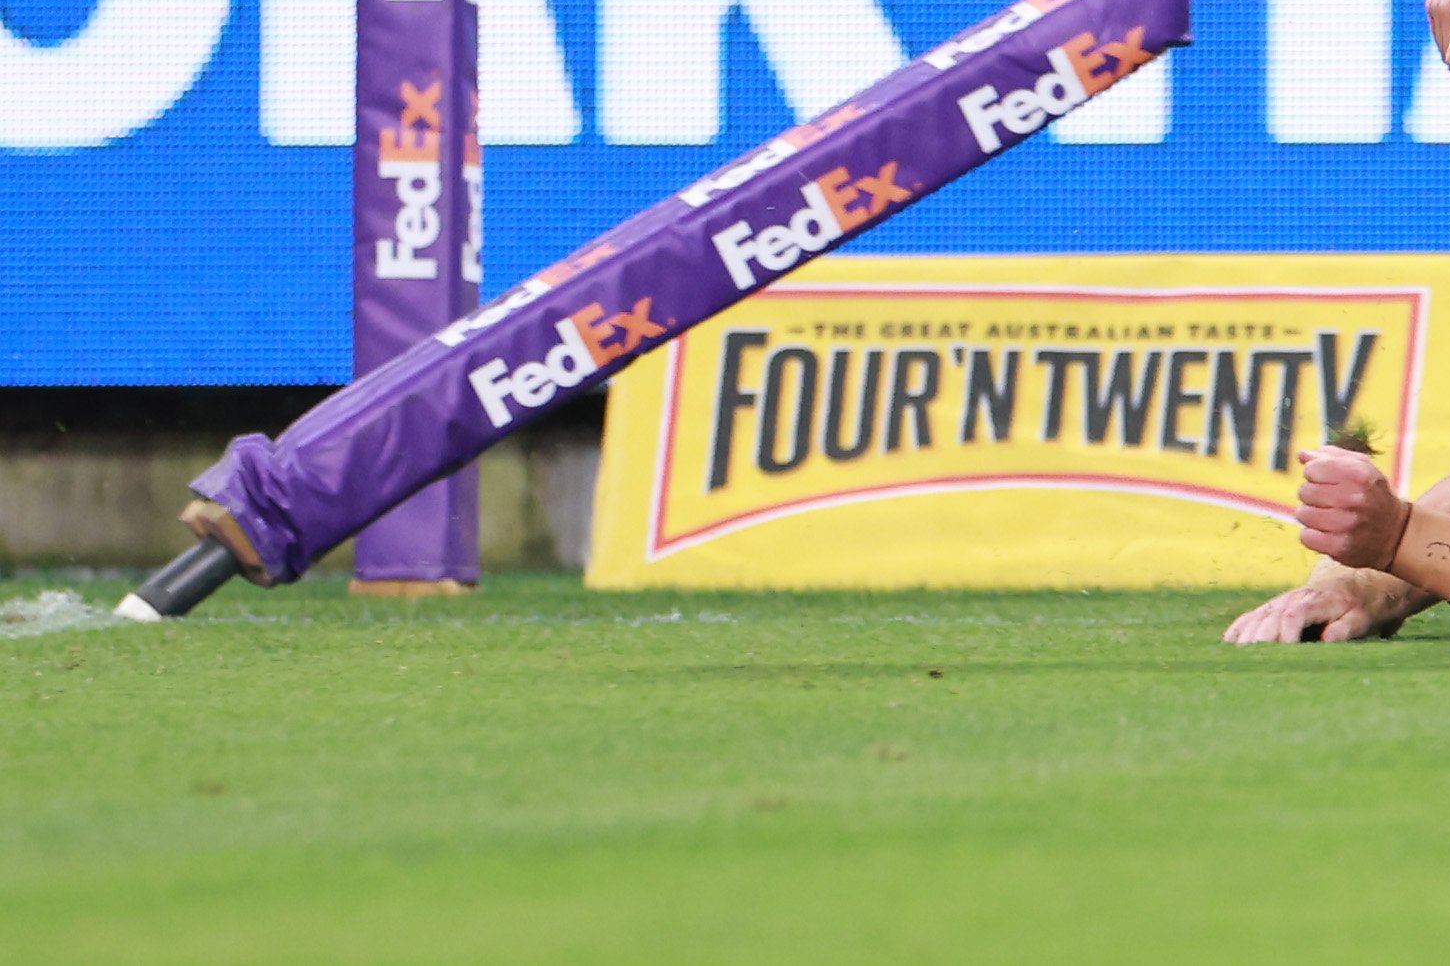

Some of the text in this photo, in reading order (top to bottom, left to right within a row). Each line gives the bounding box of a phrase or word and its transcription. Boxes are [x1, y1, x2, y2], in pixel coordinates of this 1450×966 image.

[957, 25, 1157, 154] FedEx
[376, 81, 443, 280] FedEx
[711, 160, 913, 291] FedEx
[468, 296, 670, 429] FedEx
[814, 322, 1276, 341] THE GREAT AUSTRALIAN TASTE
[1034, 329, 1381, 473] TWENTY
